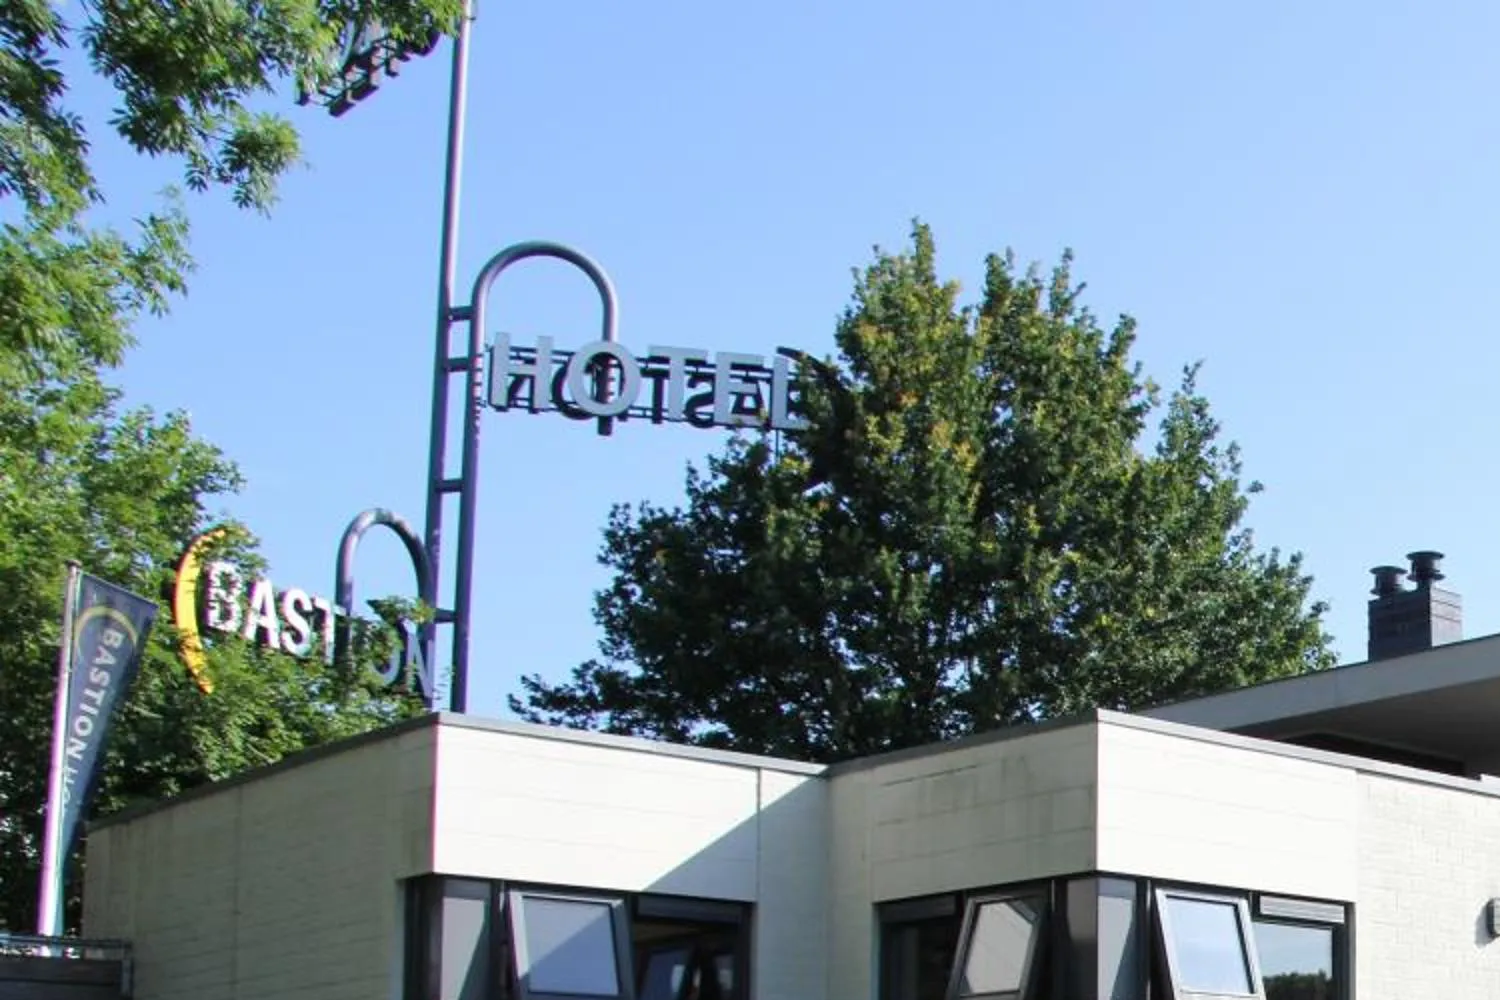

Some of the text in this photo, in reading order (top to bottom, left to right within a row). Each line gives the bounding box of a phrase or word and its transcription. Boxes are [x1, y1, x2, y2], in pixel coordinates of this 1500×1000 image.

[491, 332, 812, 430] HOTEL
[66, 628, 125, 761] BASTION
[205, 561, 435, 700] BASTN
